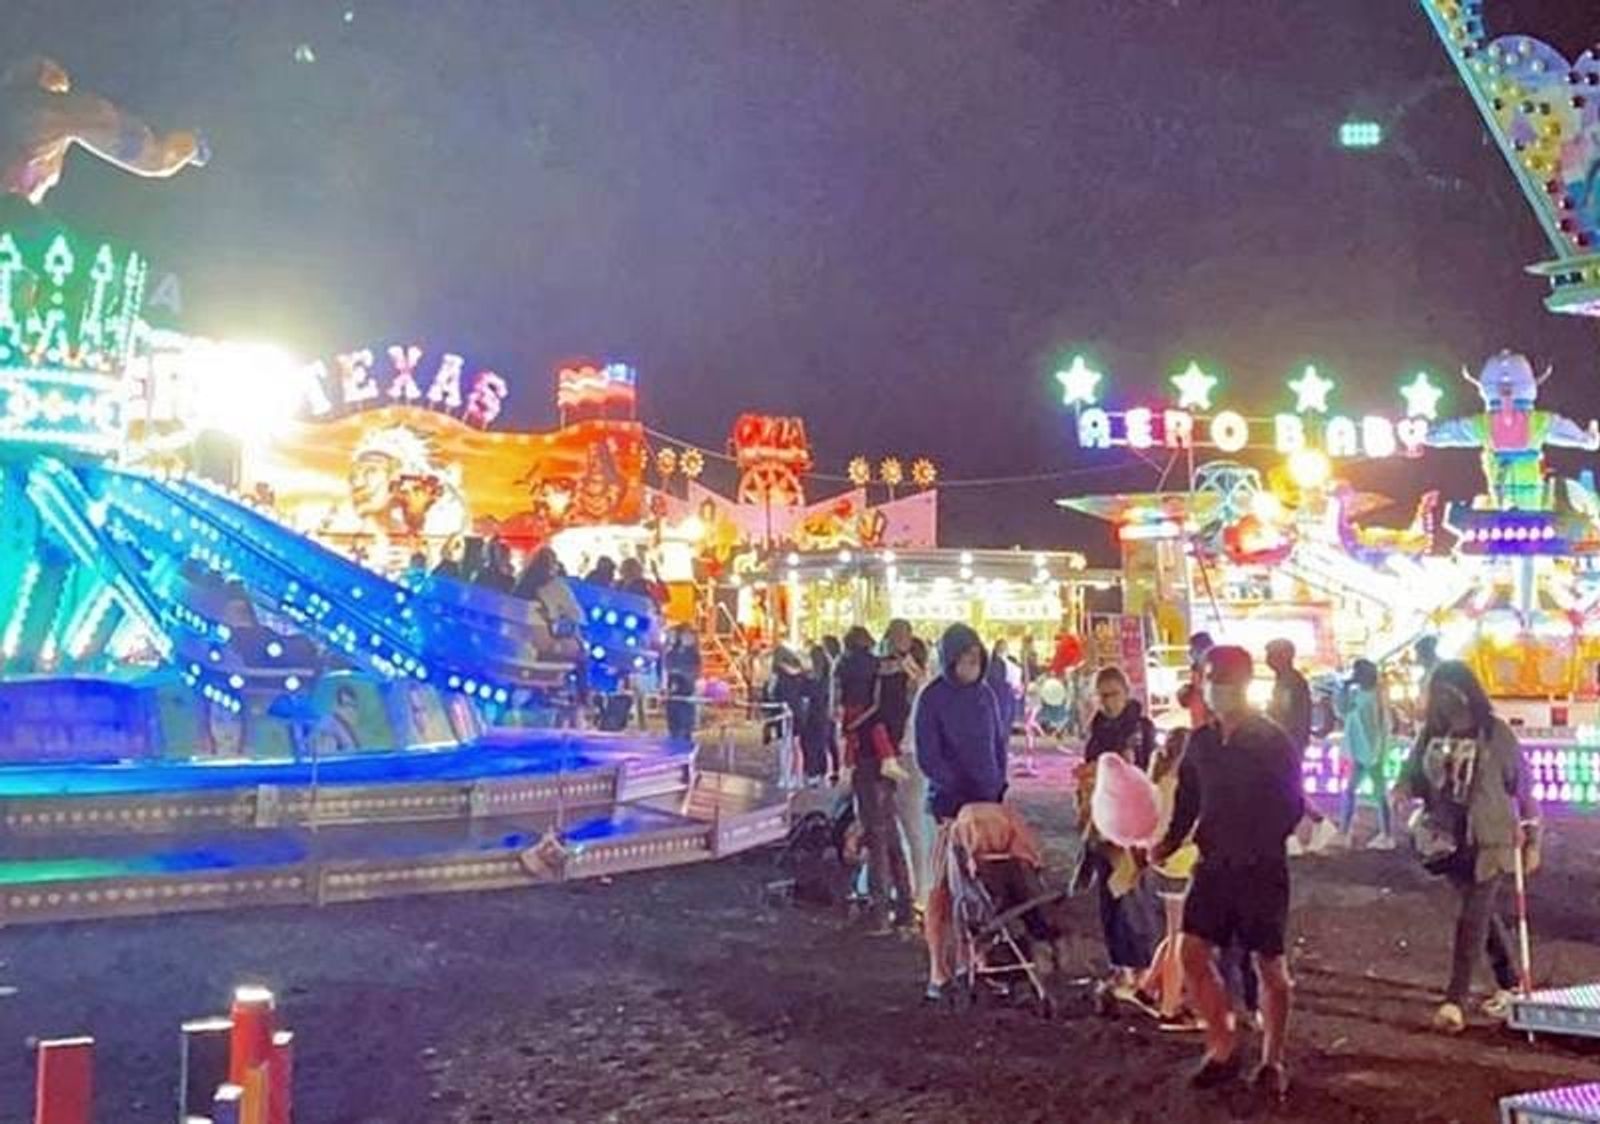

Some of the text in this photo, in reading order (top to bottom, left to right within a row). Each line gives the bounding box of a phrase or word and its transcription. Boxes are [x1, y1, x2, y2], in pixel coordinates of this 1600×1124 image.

[304, 345, 508, 424] TEXAS
[1078, 407, 1428, 458] AERO BABY
